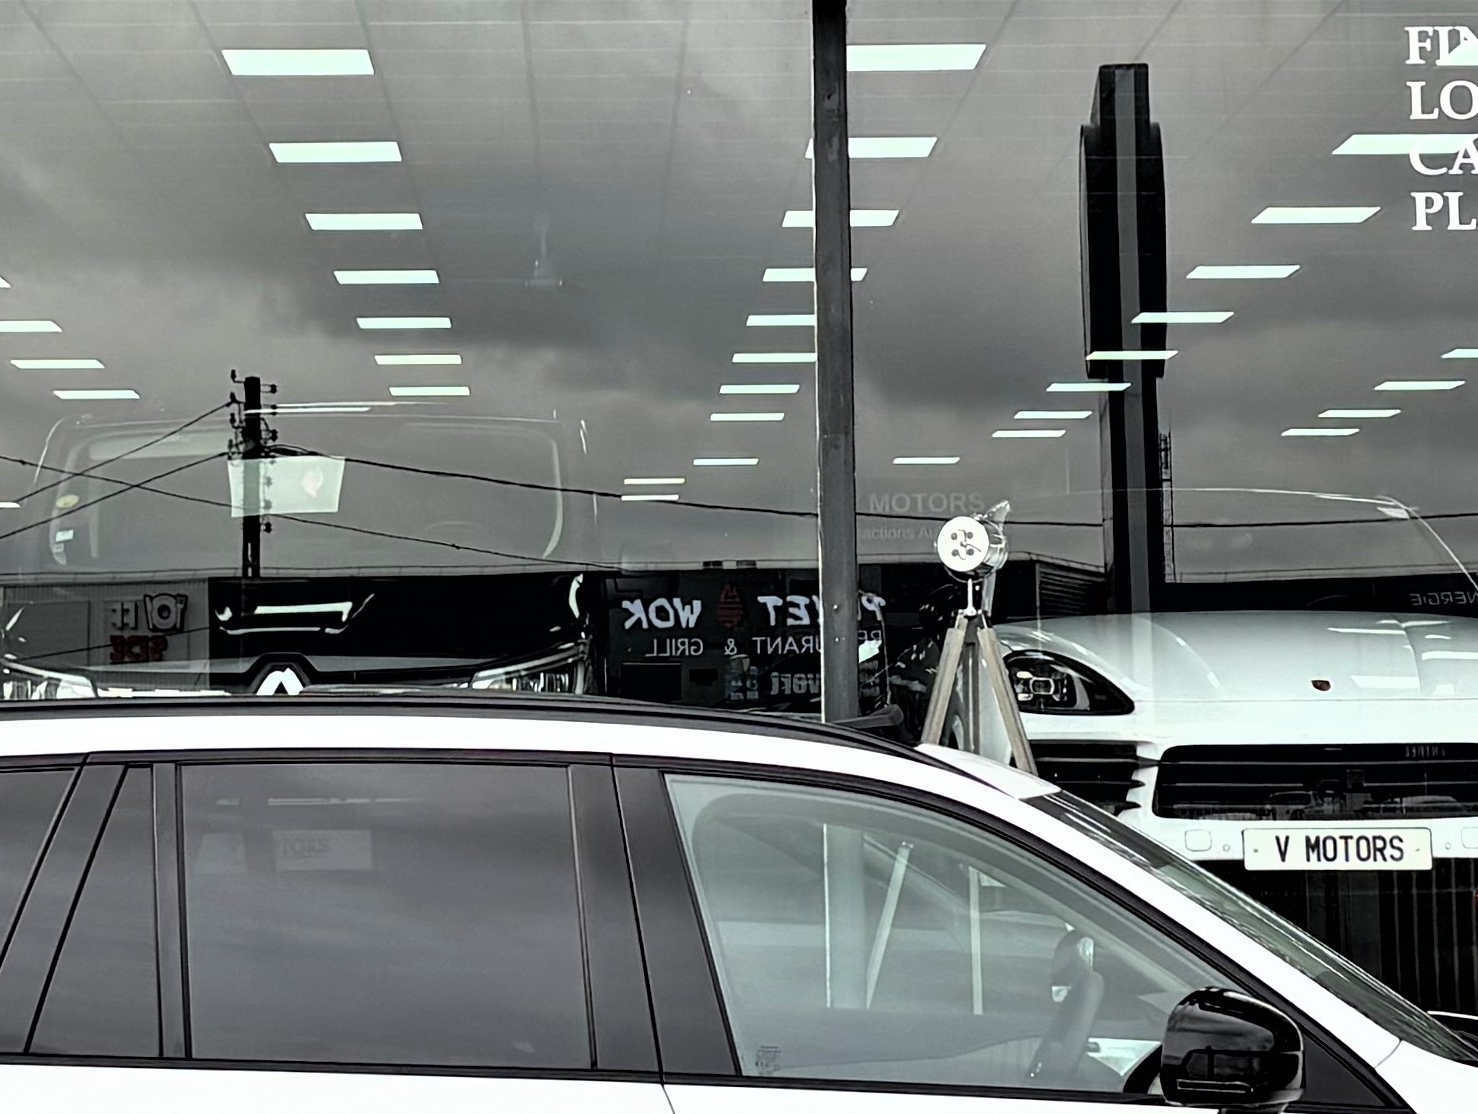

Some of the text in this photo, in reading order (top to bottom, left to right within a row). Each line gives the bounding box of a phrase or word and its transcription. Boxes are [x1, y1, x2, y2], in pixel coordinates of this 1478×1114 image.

[869, 492, 985, 514] MOTORS
[1274, 835, 1405, 862] V MOTORS
